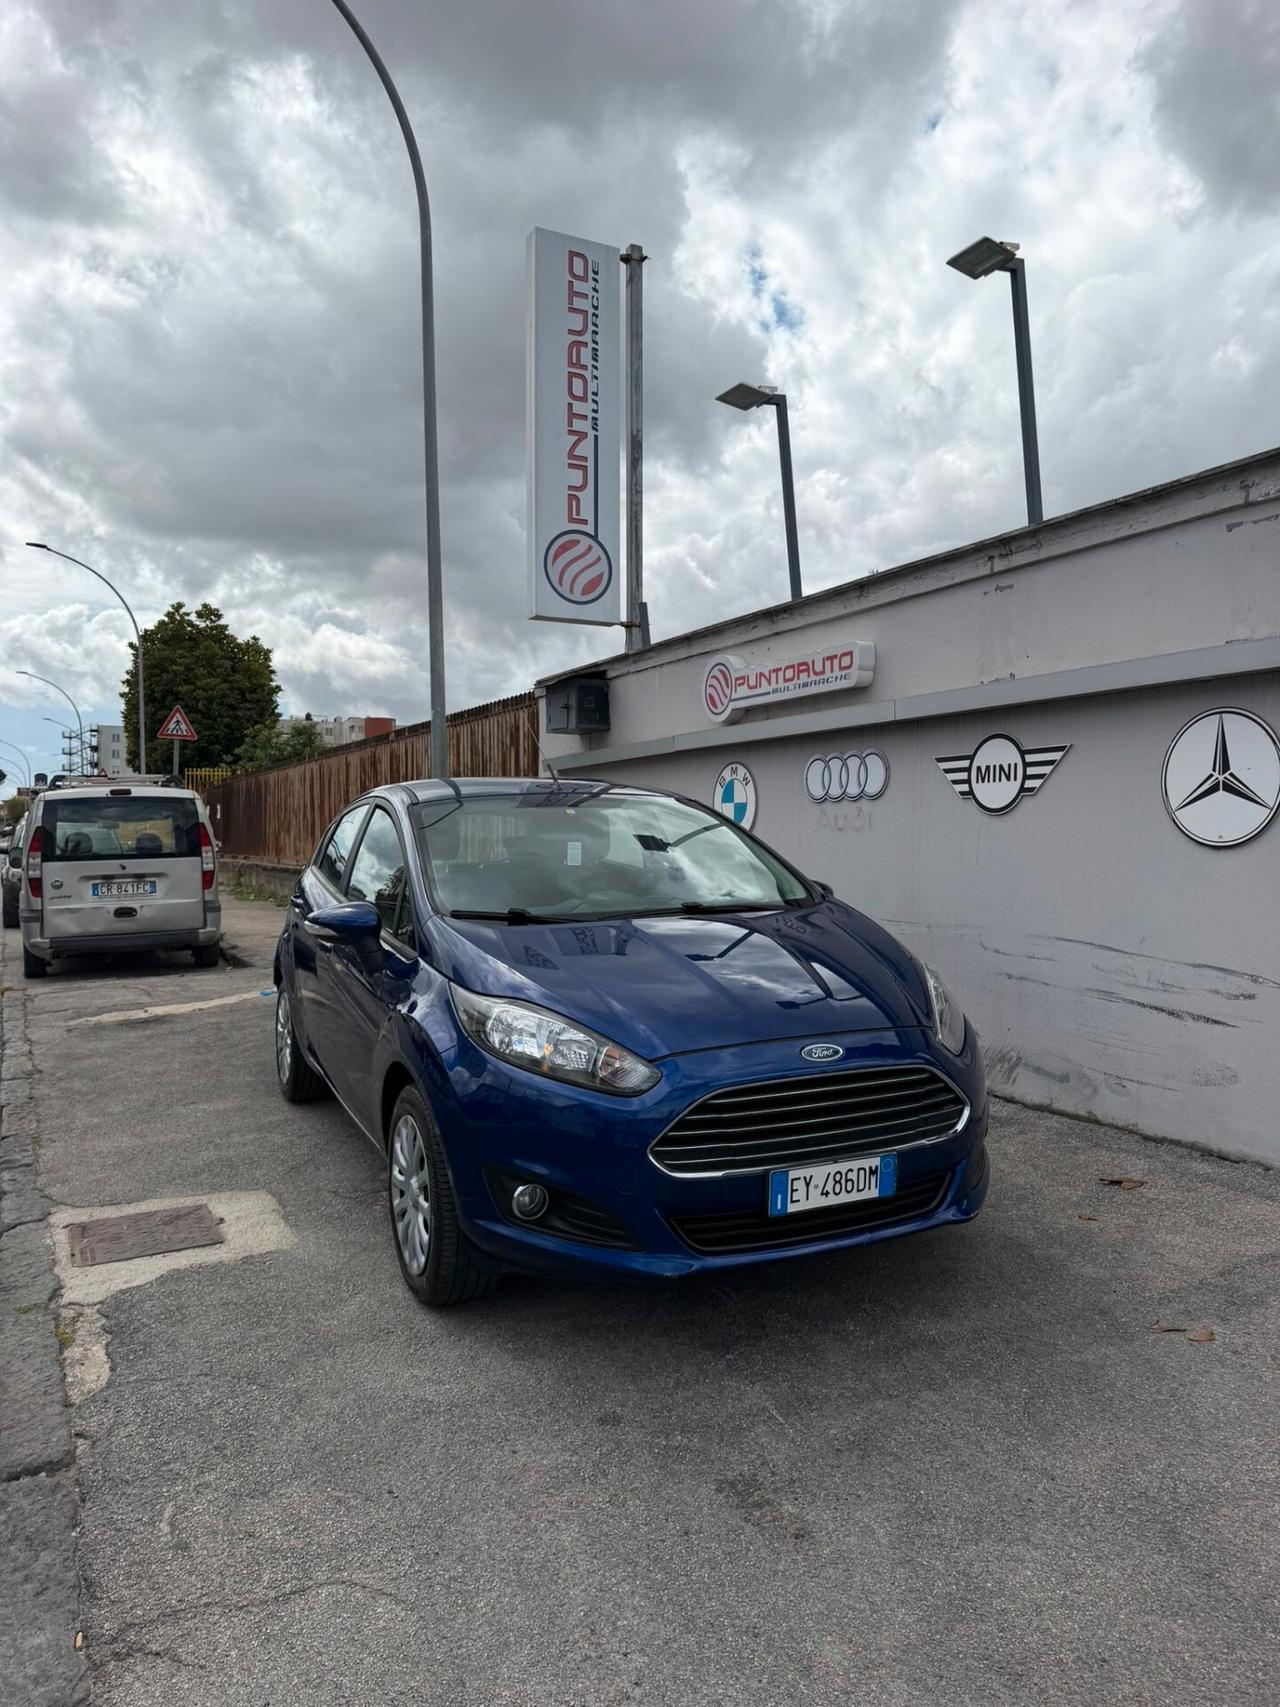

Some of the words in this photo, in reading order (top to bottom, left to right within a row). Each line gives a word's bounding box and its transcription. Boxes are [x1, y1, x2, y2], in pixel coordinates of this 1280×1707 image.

[591, 258, 600, 433] MULTIMARCHE
[567, 250, 589, 526] PUNTOAUTO
[733, 650, 854, 694] PUNTOAUTO
[771, 672, 853, 695] MULTIMARCHE
[718, 766, 751, 788] BMW
[975, 762, 1018, 784] MINI
[811, 1047, 834, 1058] Ford
